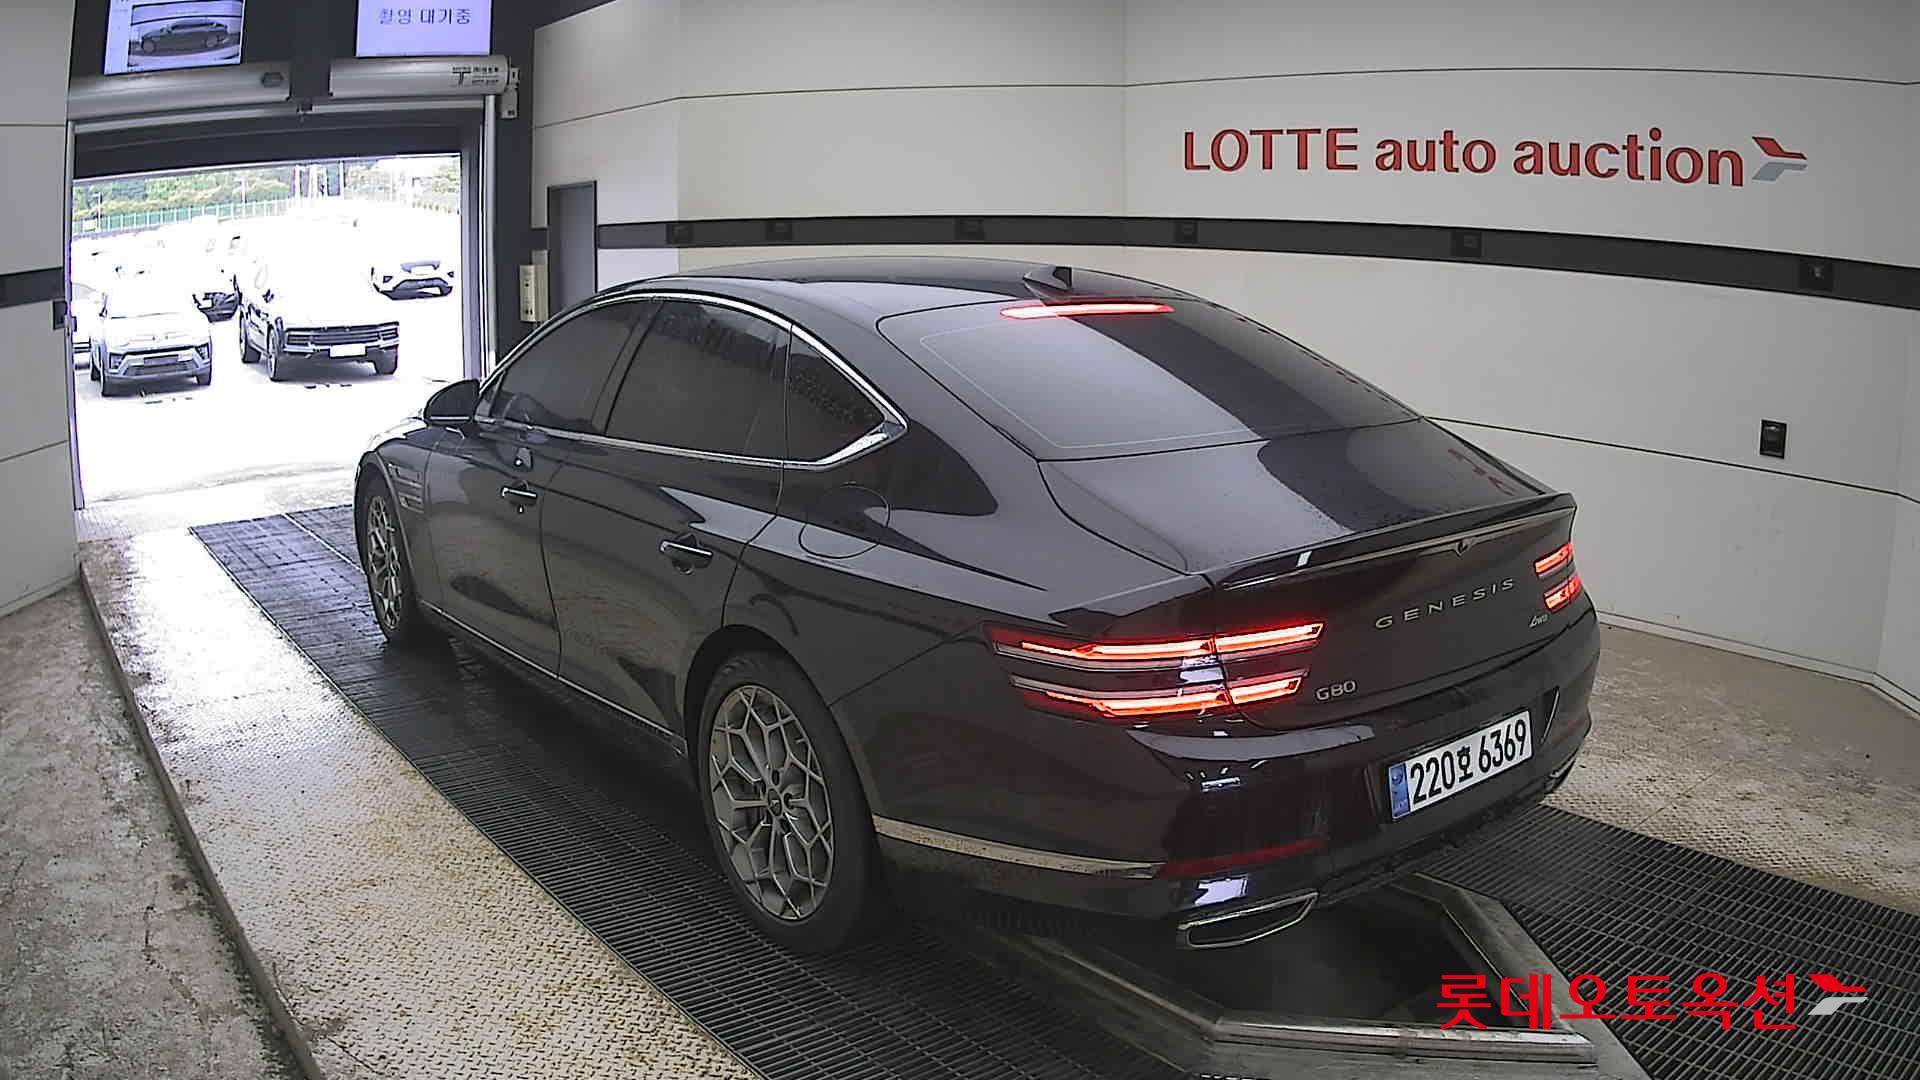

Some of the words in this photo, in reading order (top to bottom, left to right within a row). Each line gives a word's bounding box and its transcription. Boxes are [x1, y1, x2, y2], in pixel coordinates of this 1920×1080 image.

[1184, 127, 1360, 172] LOTTE
[1376, 130, 1497, 174] auto
[1513, 127, 1744, 187] auction
[1375, 578, 1514, 629] GENESIS
[1316, 680, 1356, 701] G80
[1410, 745, 1474, 805] 220호
[1479, 719, 1526, 773] 6369
